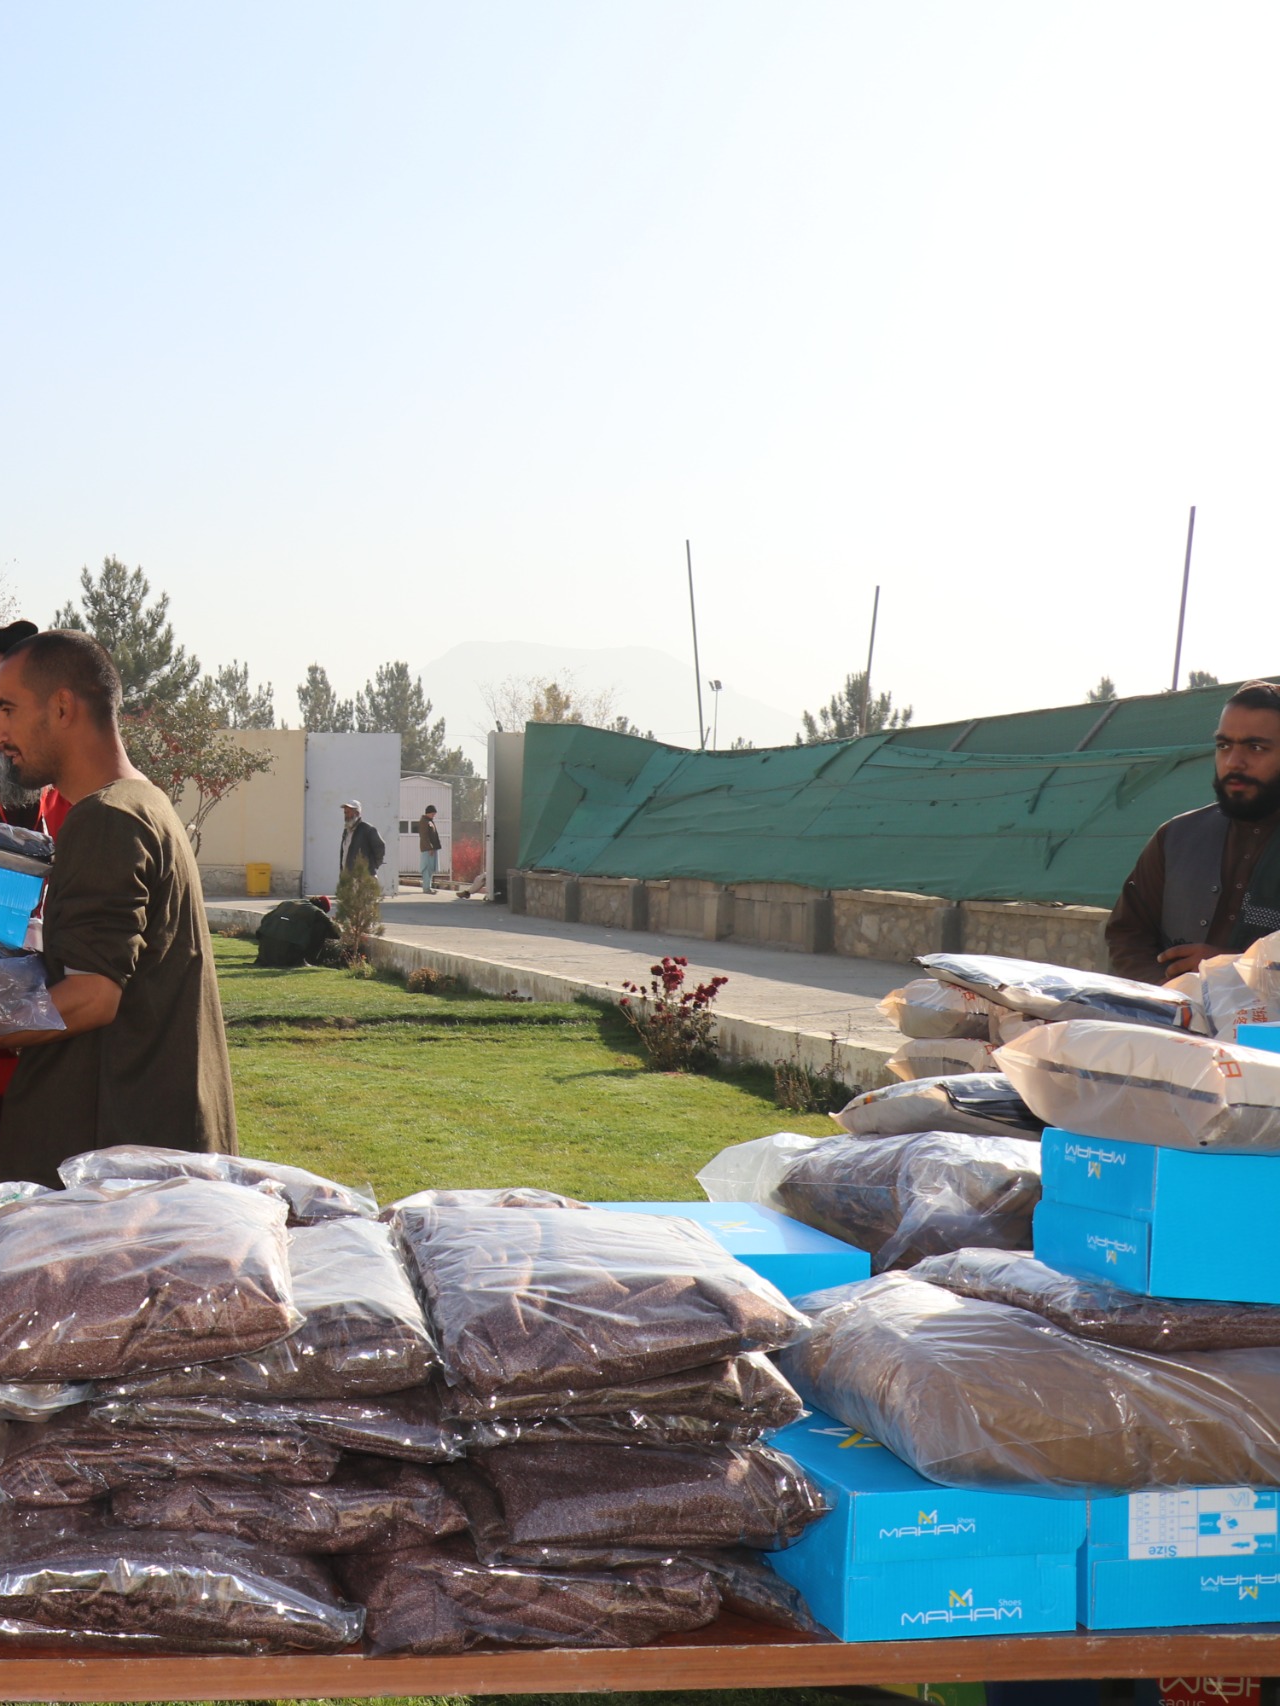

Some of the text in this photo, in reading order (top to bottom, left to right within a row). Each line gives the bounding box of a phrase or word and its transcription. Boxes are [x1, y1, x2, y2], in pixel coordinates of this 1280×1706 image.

[1065, 1142, 1126, 1165] MAHAM
[1087, 1233, 1136, 1254] MAHAM
[879, 1523, 976, 1539] MAHAM
[1148, 1545, 1178, 1557] Size
[1200, 1574, 1280, 1586] AHAM
[901, 1606, 1022, 1626] MAHAM
